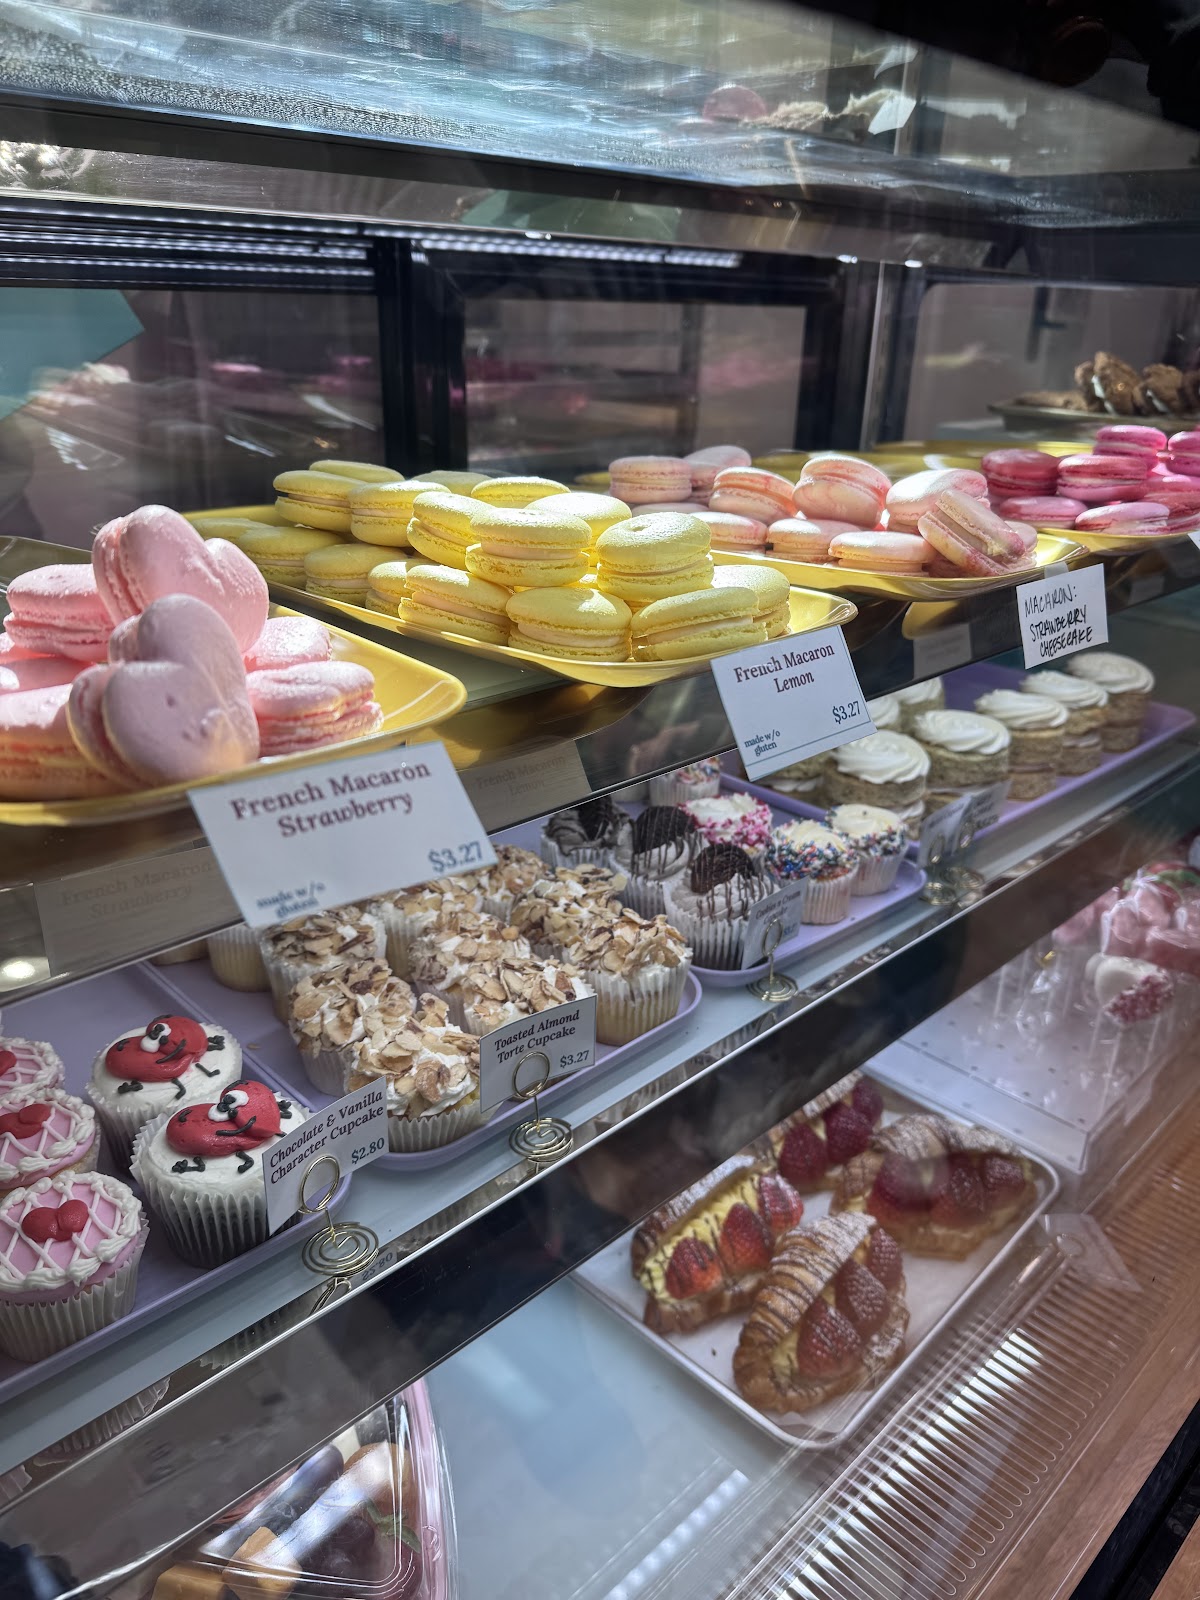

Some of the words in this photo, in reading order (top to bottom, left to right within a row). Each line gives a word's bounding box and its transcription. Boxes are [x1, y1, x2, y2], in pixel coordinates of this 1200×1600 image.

[1030, 604, 1087, 642] STRAWBERRY
[1039, 626, 1093, 657] CHEESECAKE
[733, 657, 783, 683] French
[782, 644, 835, 669] Macaron
[774, 670, 815, 693] Lemon
[832, 701, 861, 724] $3.27
[744, 733, 765, 748] made
[765, 729, 781, 742] w/o
[753, 741, 777, 757] gluten
[229, 782, 324, 820] French
[328, 762, 431, 797] Macaron
[277, 793, 414, 838] Strawberry
[428, 841, 483, 873] $3.27
[494, 1024, 535, 1052] Toasted
[537, 1010, 580, 1033] Almond
[497, 1044, 525, 1064] Torte
[527, 1026, 576, 1049] Cupcake
[559, 1049, 590, 1068] $3.27
[270, 1123, 324, 1168] Chocolate
[326, 1114, 337, 1128] &
[338, 1090, 383, 1120] Vanilla
[270, 1135, 327, 1184] Character
[330, 1106, 384, 1140] Cupcake
[351, 1137, 385, 1165] $2.80
